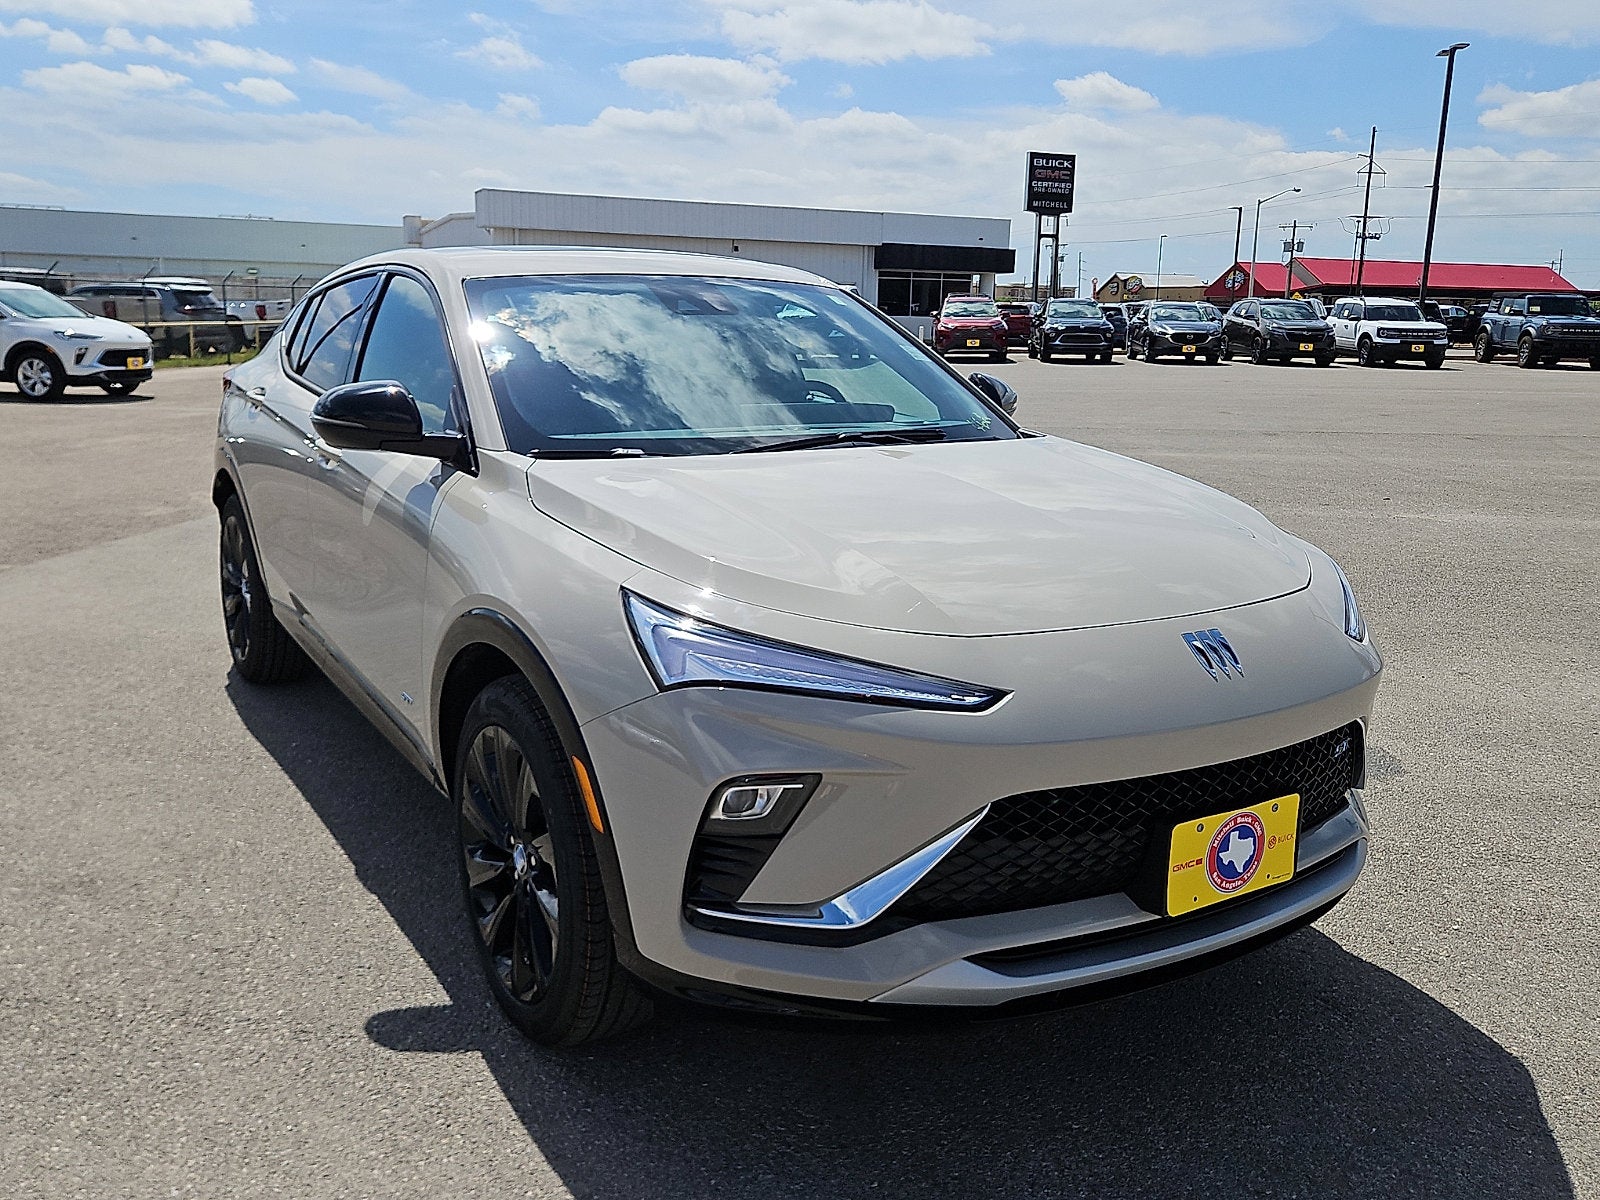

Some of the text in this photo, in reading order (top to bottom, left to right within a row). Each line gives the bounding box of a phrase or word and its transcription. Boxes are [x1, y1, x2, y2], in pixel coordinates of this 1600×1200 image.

[1033, 158, 1073, 168] BUICK
[1034, 169, 1071, 180] GMC
[1031, 181, 1072, 189] CERTIFIED
[1032, 200, 1068, 209] MITCHELL
[1213, 820, 1235, 848] Mitchell
[1236, 815, 1252, 824] Buick
[1277, 833, 1294, 844] BUICK
[1172, 858, 1196, 873] GMC
[1212, 871, 1222, 886] San
